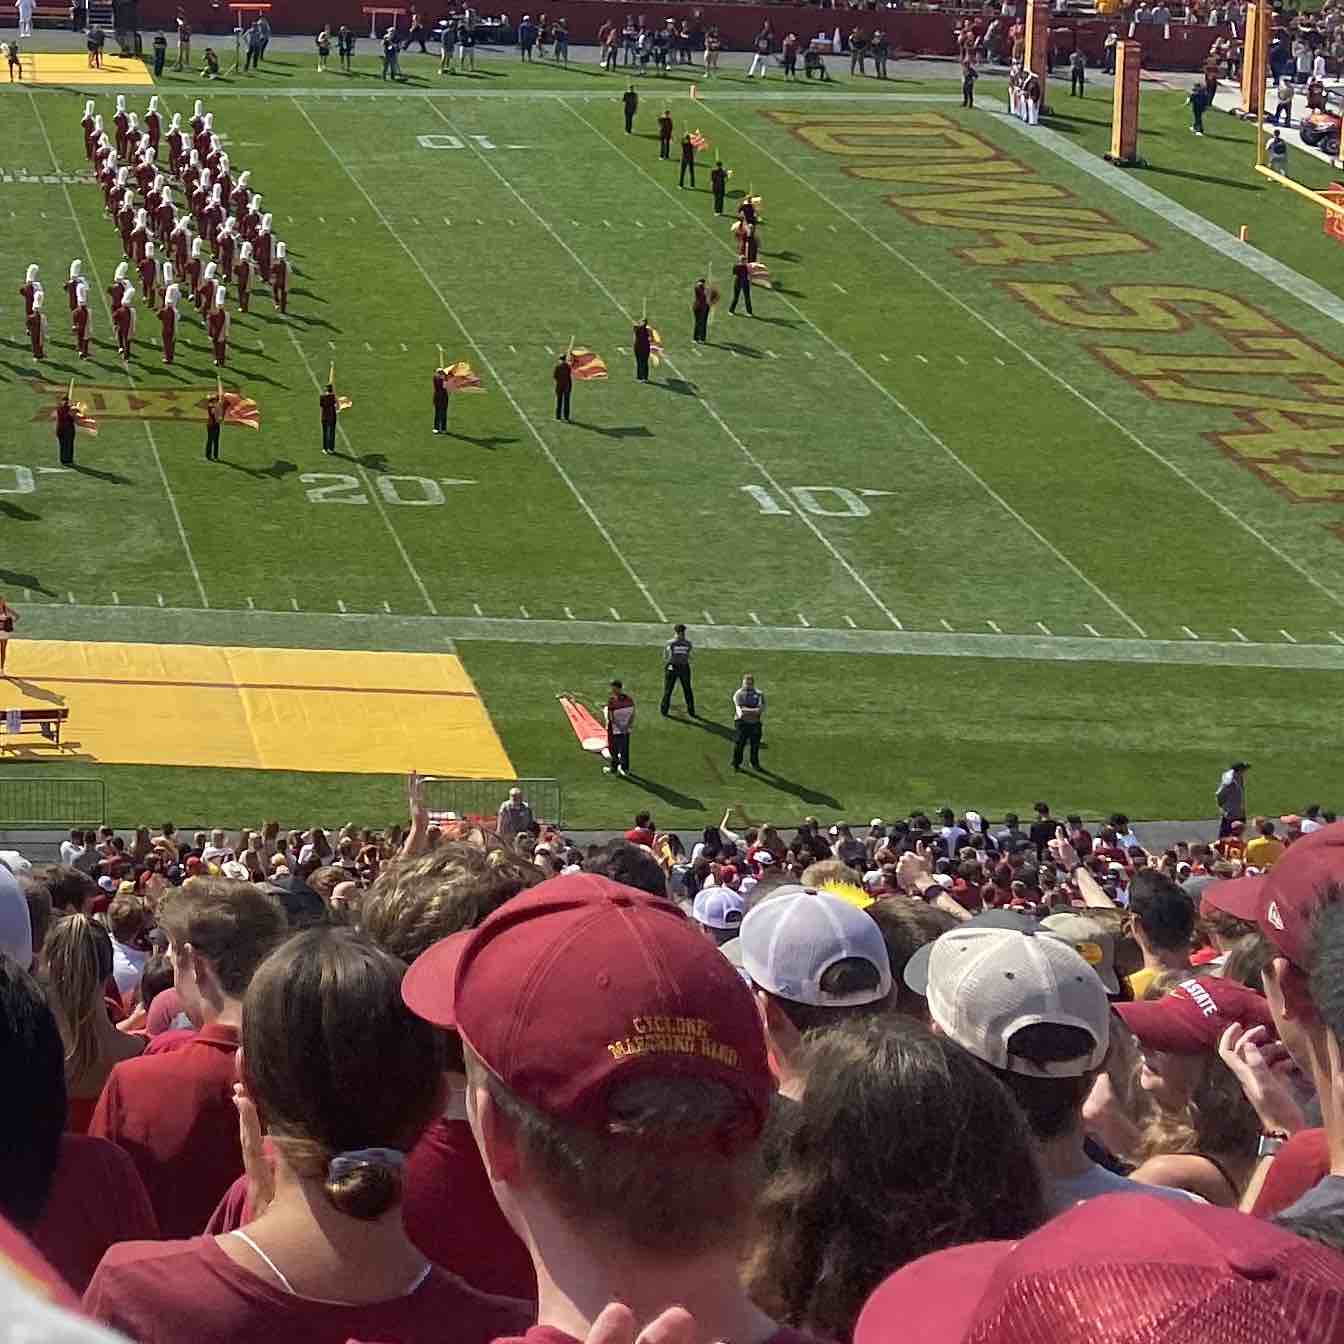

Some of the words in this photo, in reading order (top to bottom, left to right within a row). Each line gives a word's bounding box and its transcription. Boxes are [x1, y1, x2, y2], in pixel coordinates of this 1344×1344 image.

[298, 472, 448, 506] 20
[739, 483, 872, 518] 10
[632, 1015, 709, 1038] CYCLONE
[607, 1034, 697, 1060] MARCHING
